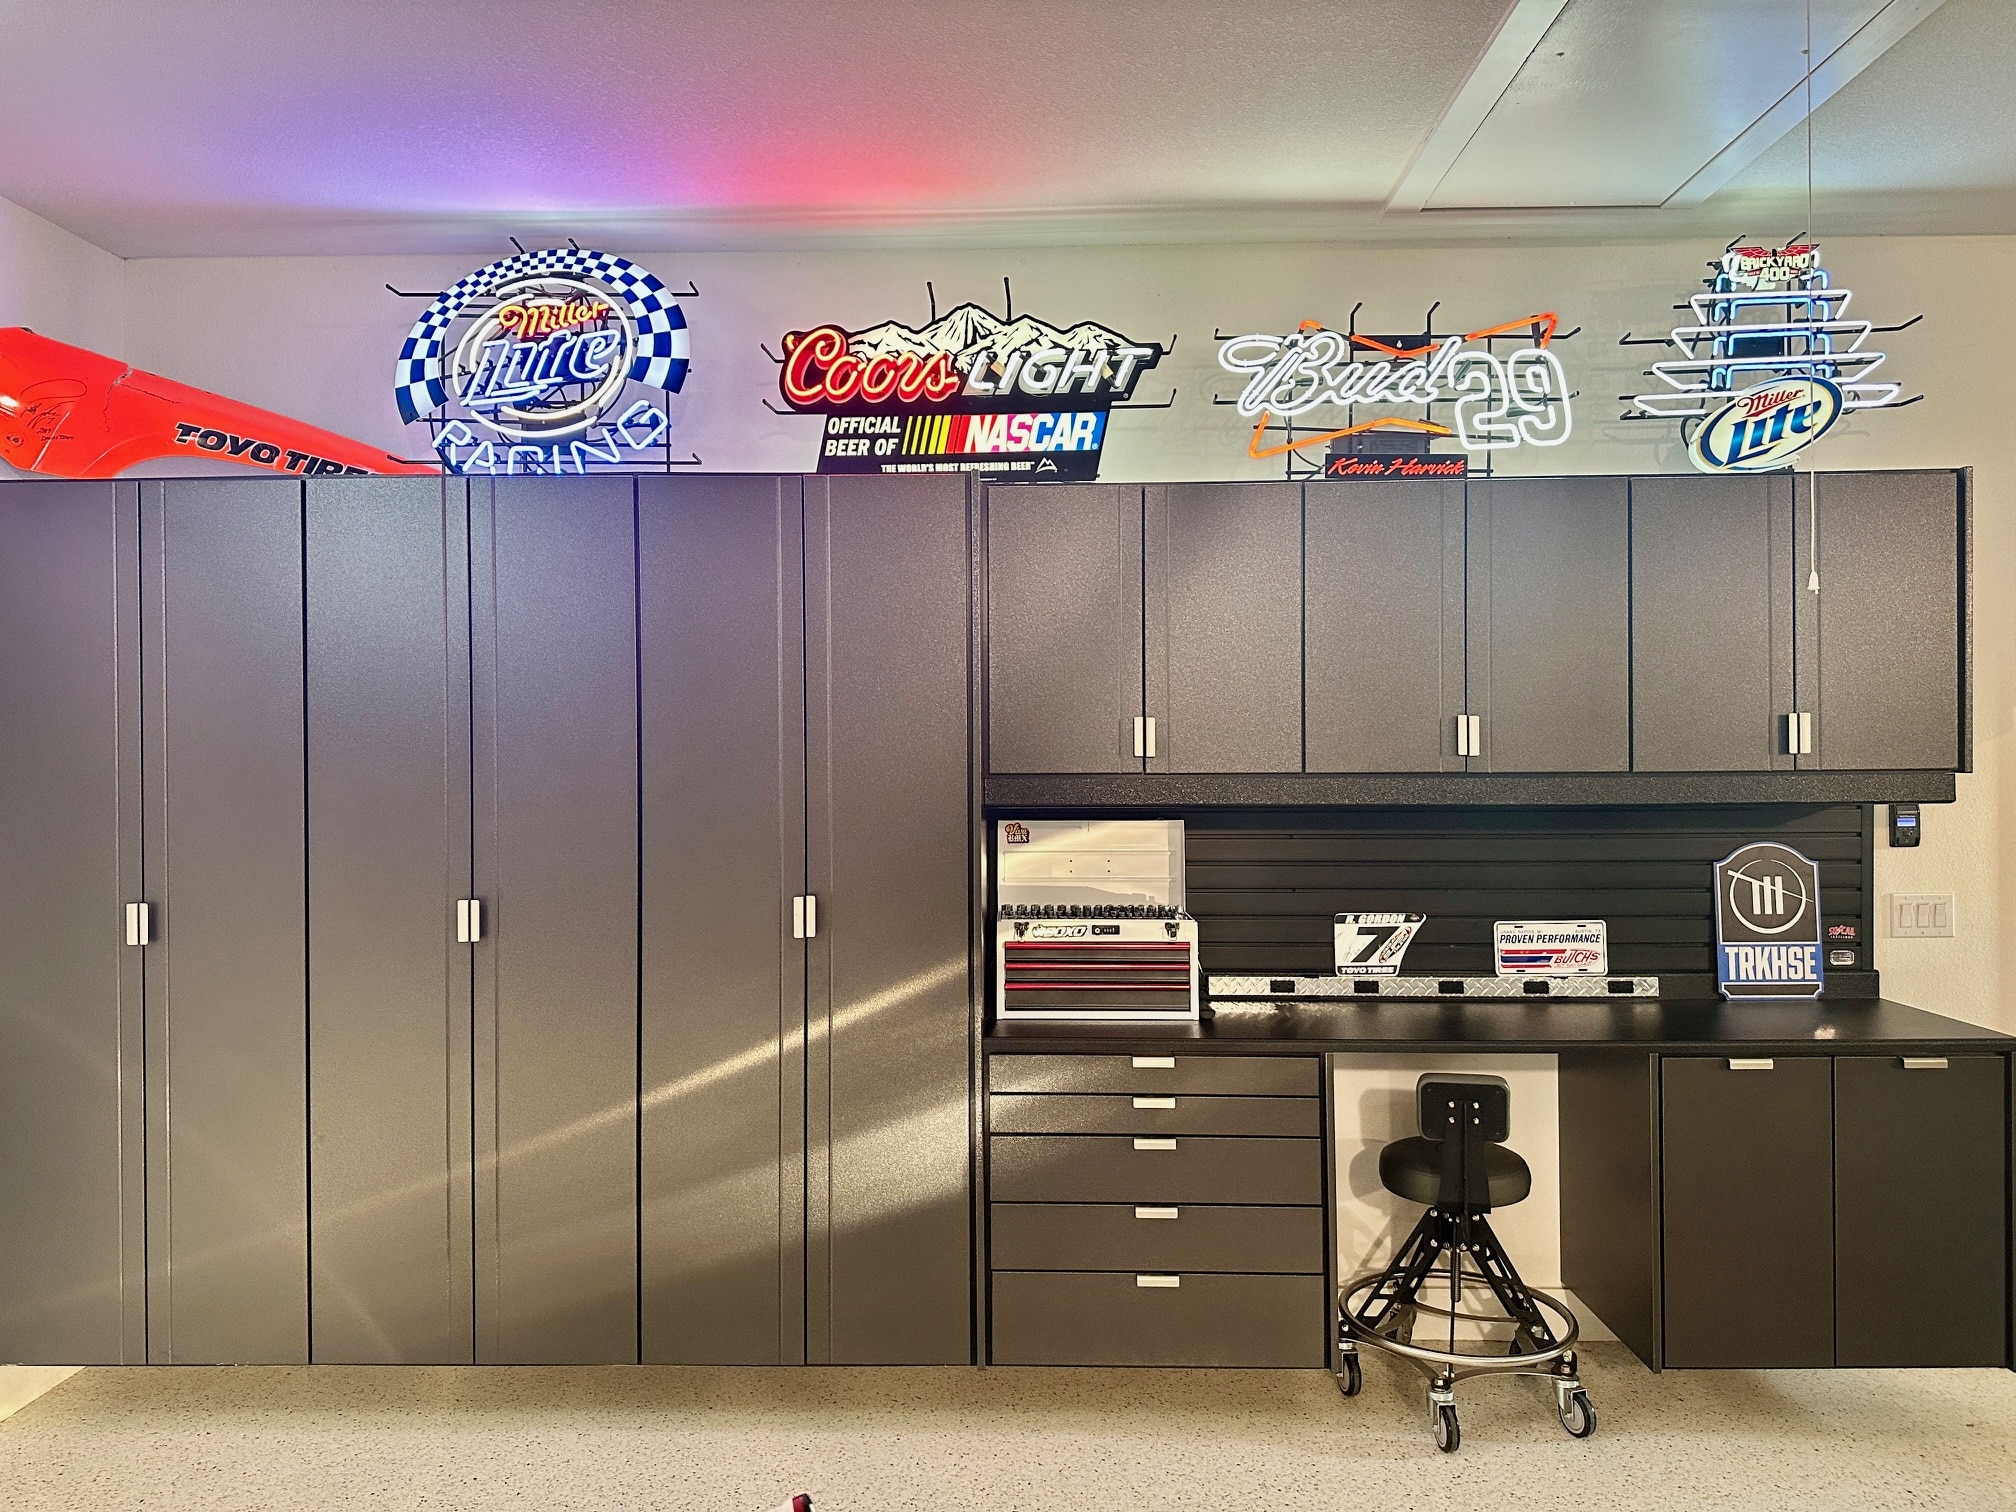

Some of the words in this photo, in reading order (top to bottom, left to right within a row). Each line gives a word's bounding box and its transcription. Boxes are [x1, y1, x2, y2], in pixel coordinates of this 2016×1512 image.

[1740, 253, 1810, 272] BRICKYARD
[1760, 267, 1791, 281] 400
[499, 301, 610, 340] Miller
[783, 326, 961, 403] Coors
[961, 347, 1154, 399] LIGHT
[1218, 330, 1463, 417] Bud
[1447, 345, 1574, 450] 29
[1736, 387, 1806, 418] Miller
[432, 399, 668, 474] RACING
[827, 416, 902, 435] OFFICIAL
[963, 411, 1097, 453] NASCAR
[1720, 399, 1823, 468] Lite
[176, 422, 281, 464] TOYO
[286, 450, 380, 475] TIR
[824, 438, 871, 457] BEER
[874, 438, 899, 456] OF
[880, 464, 897, 473] THE
[898, 463, 934, 473] WORLD'S
[935, 462, 960, 472] MOST
[960, 461, 1010, 472] REFRESHING
[1010, 461, 1032, 471] BEER
[1358, 914, 1405, 924] GORDON
[1350, 926, 1401, 963] 7
[1500, 934, 1534, 944] PROVEN
[1536, 933, 1602, 944] PERFORMANCE
[1367, 966, 1395, 974] TIRES
[1724, 946, 1818, 981] TRKHSE
